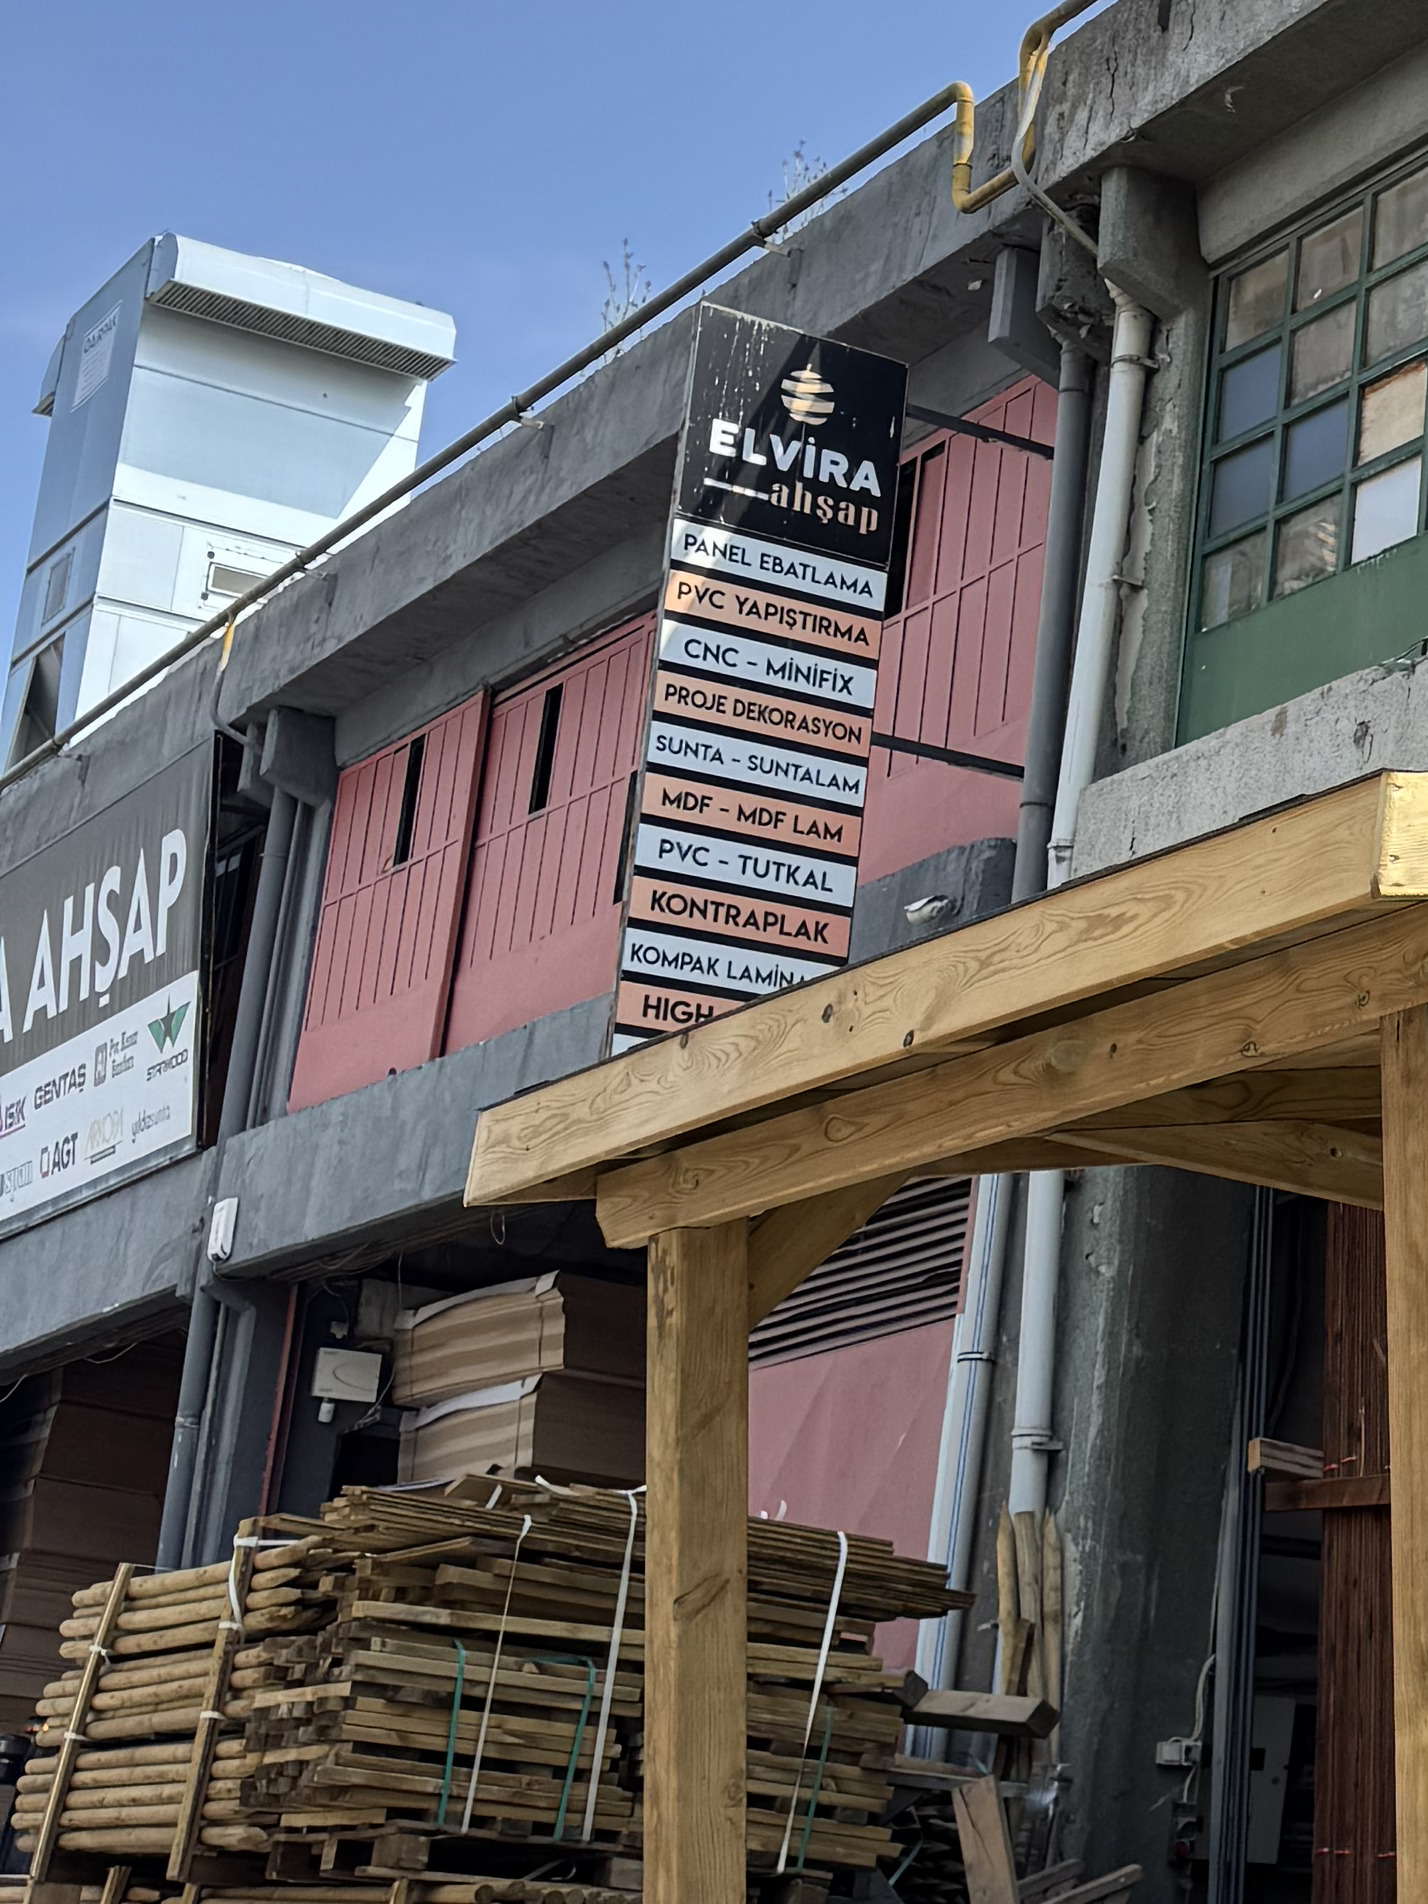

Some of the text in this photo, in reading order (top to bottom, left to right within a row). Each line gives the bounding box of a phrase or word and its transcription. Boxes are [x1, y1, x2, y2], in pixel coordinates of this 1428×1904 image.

[708, 417, 882, 498] ELVİRA
[769, 480, 879, 535] ahşap
[684, 532, 874, 599] PANEL EBATLAMA
[677, 581, 870, 647] PVC YAPIŞTIRMA
[684, 638, 740, 668] CNC
[765, 657, 855, 696] MİNİFİX
[664, 683, 863, 745] PROJE DEKORASYON
[655, 734, 724, 765] SUNTA
[747, 754, 861, 795] SUNTALAM
[661, 787, 713, 814] MDF
[736, 803, 787, 830] MDF
[792, 814, 844, 843] LAM
[658, 838, 711, 867] PVC
[738, 854, 834, 893] TUTKAL
[22, 828, 187, 1034] AHŞAP
[650, 889, 830, 944] KONTRAPLAK
[630, 942, 806, 989] KOMPAK LAMİN
[642, 994, 715, 1024] HIGH
[34, 1063, 87, 1110] GENTAŞ
[51, 1131, 79, 1176] AGT
